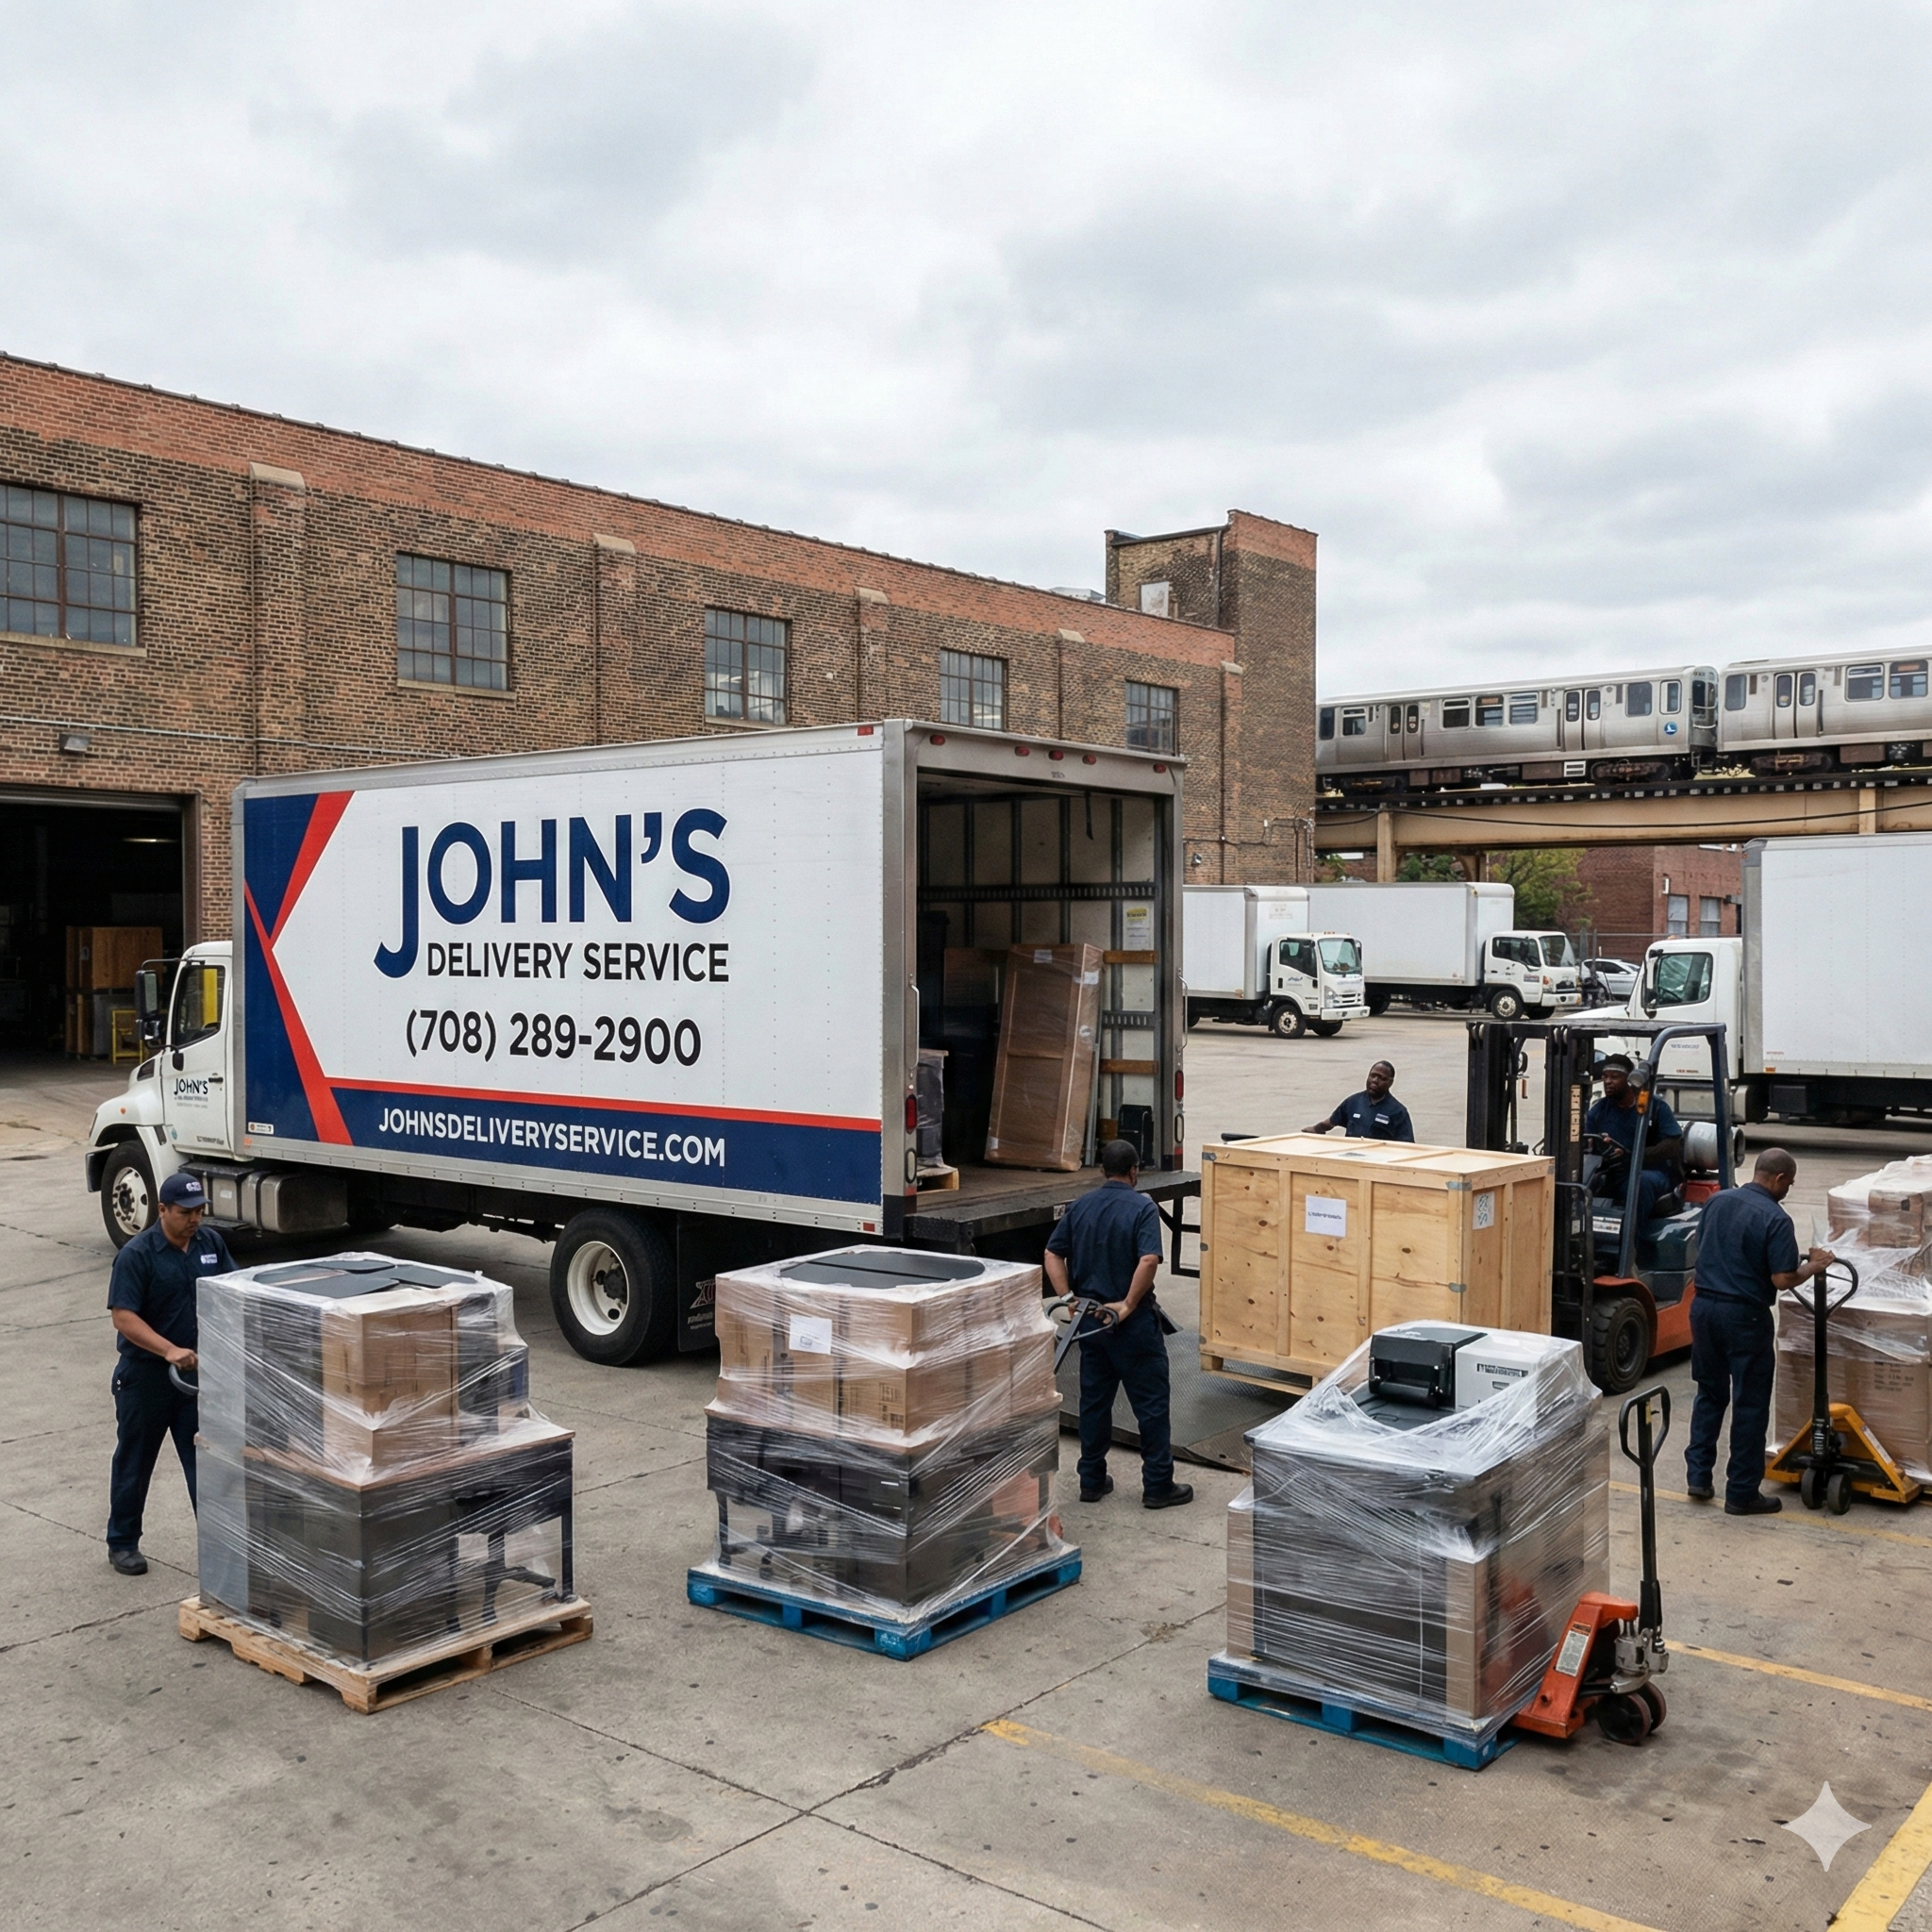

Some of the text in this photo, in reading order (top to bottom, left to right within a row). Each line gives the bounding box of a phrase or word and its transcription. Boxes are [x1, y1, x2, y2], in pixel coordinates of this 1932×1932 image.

[374, 808, 730, 978] JOHN'S
[427, 942, 729, 983] DELIVERY SERVICE
[406, 1008, 702, 1067] (708) 289-2900
[174, 1077, 208, 1095] JOHN'S
[378, 1108, 725, 1167] JOHNSDELIVERYSERVICE.COM
